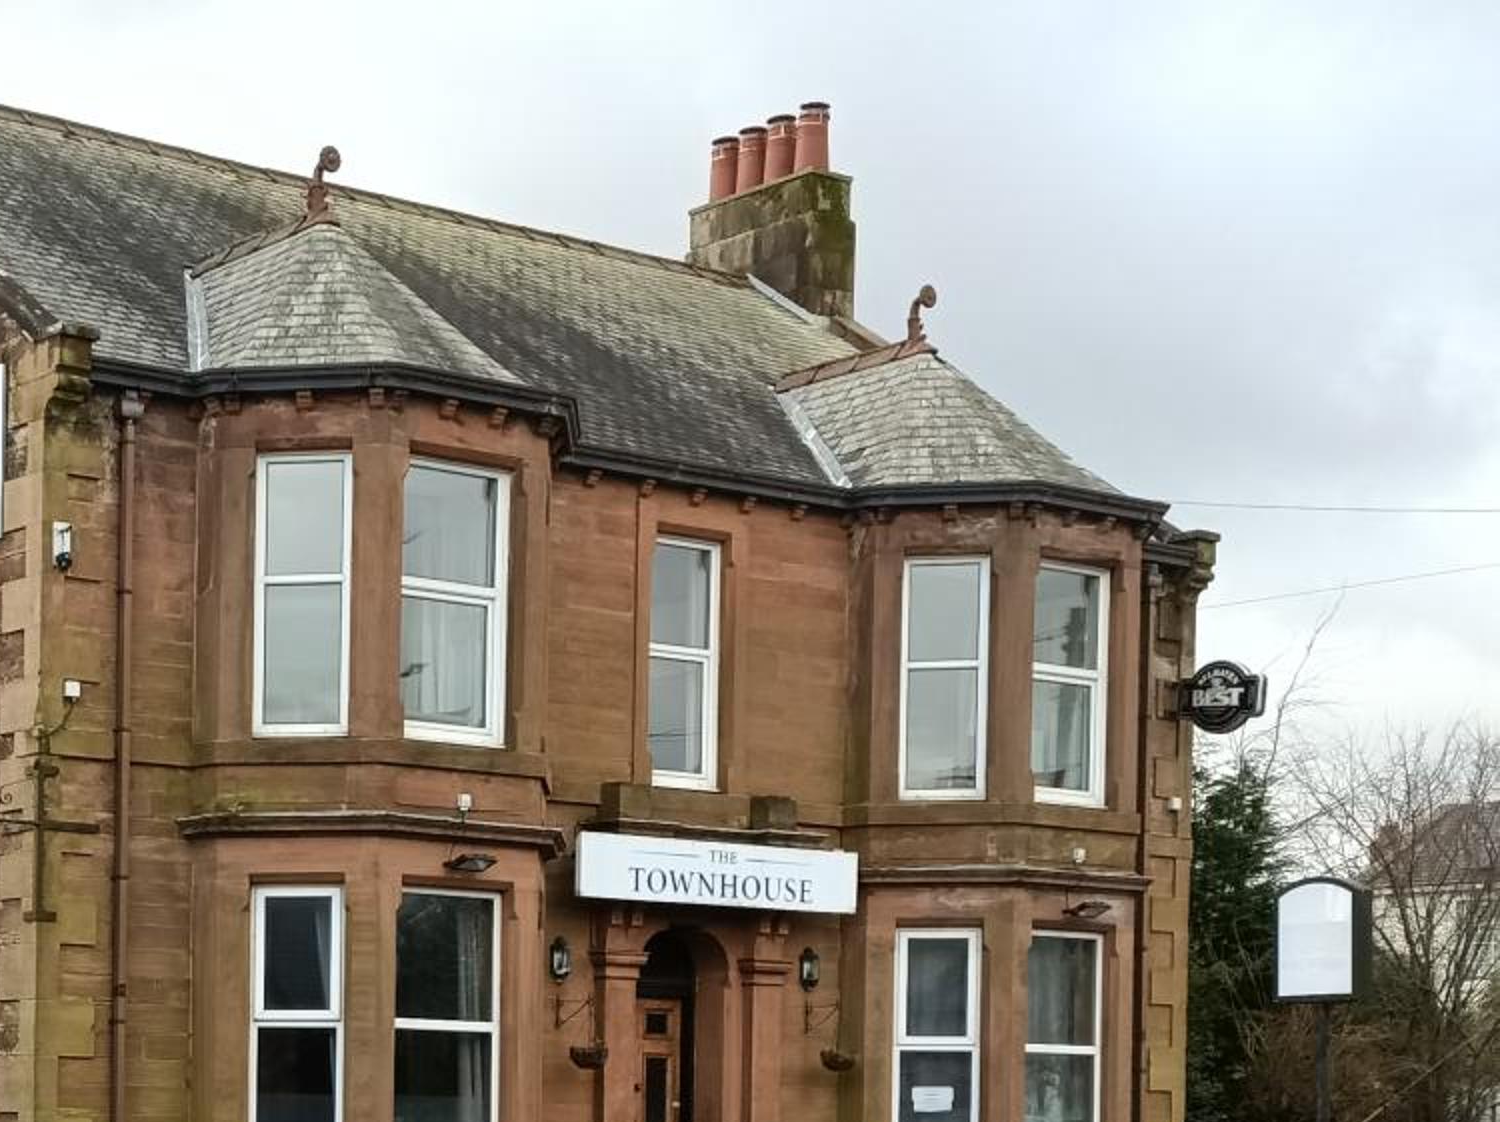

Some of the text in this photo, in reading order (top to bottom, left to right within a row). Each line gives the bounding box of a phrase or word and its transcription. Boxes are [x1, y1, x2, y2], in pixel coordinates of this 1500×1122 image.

[1191, 686, 1245, 708] BEST
[708, 849, 739, 865] THE
[628, 866, 815, 904] TOWNHOUSE
